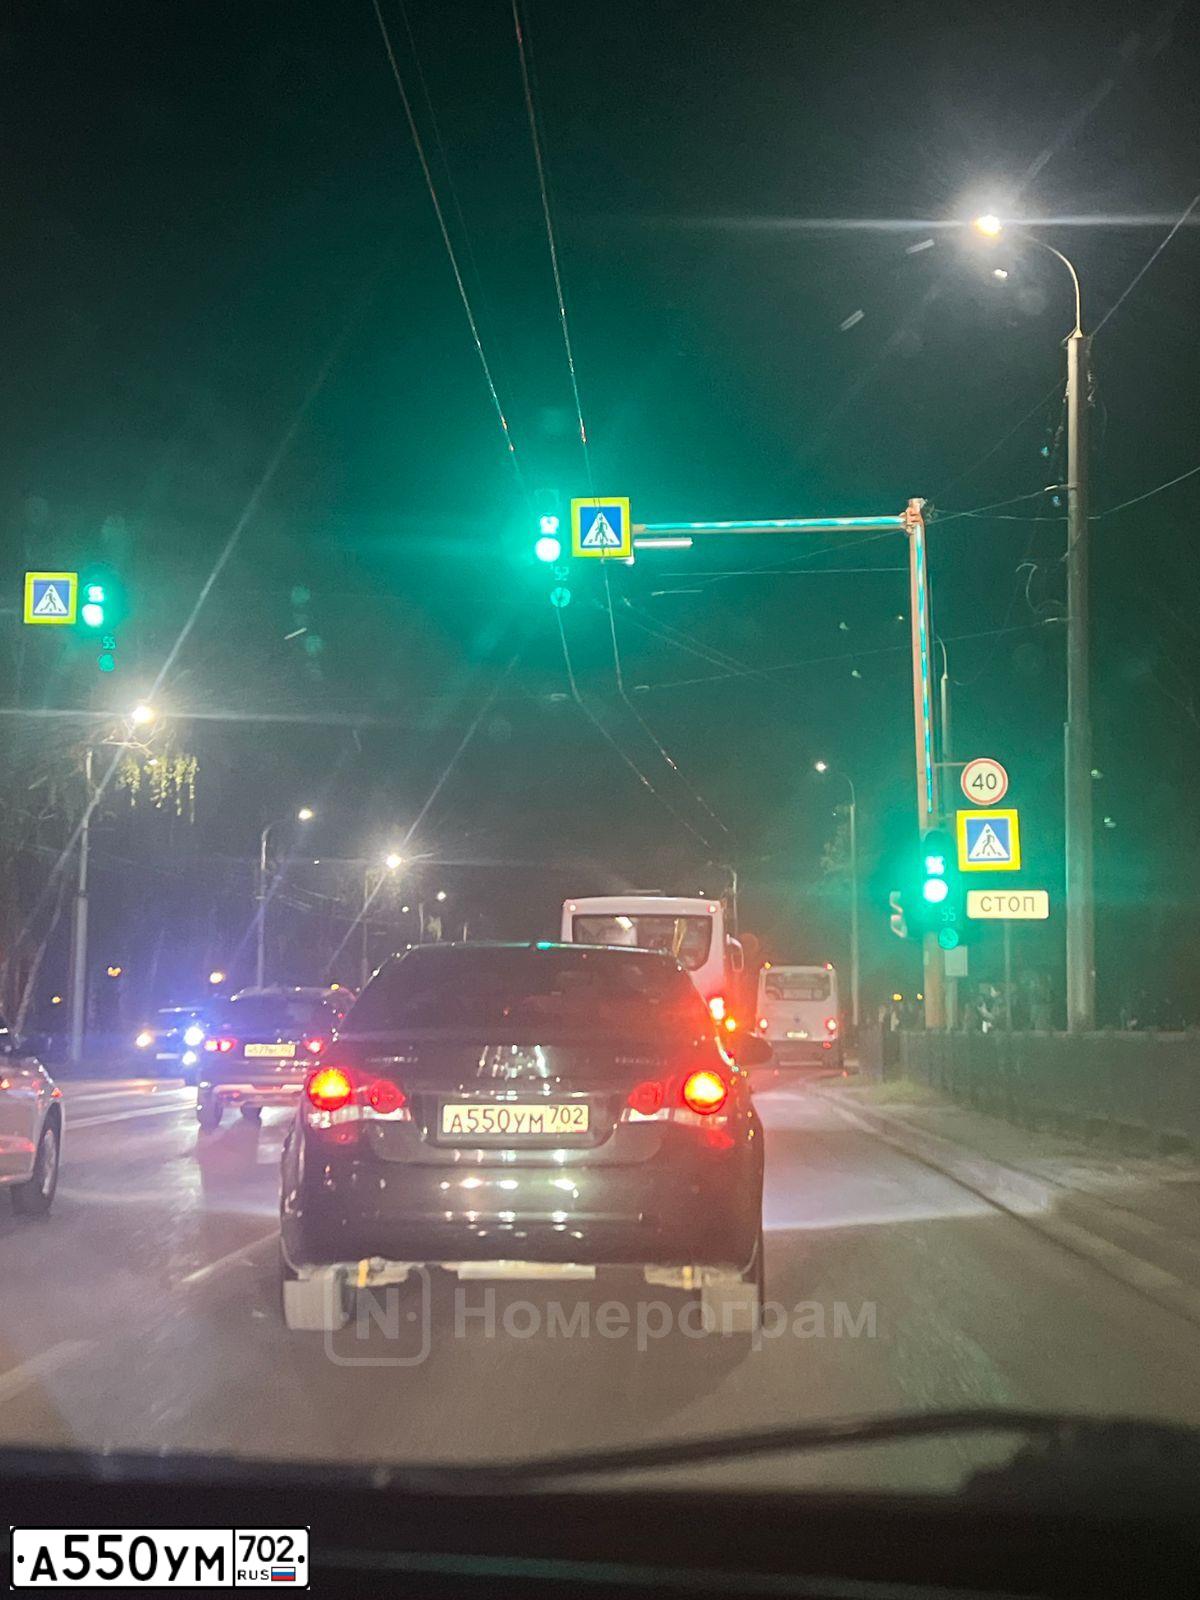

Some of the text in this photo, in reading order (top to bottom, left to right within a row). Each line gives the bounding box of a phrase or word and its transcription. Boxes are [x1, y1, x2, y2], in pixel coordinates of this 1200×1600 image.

[972, 773, 997, 790] 40
[980, 896, 1035, 912] СТОП
[451, 1106, 583, 1133] А550УМ 702
